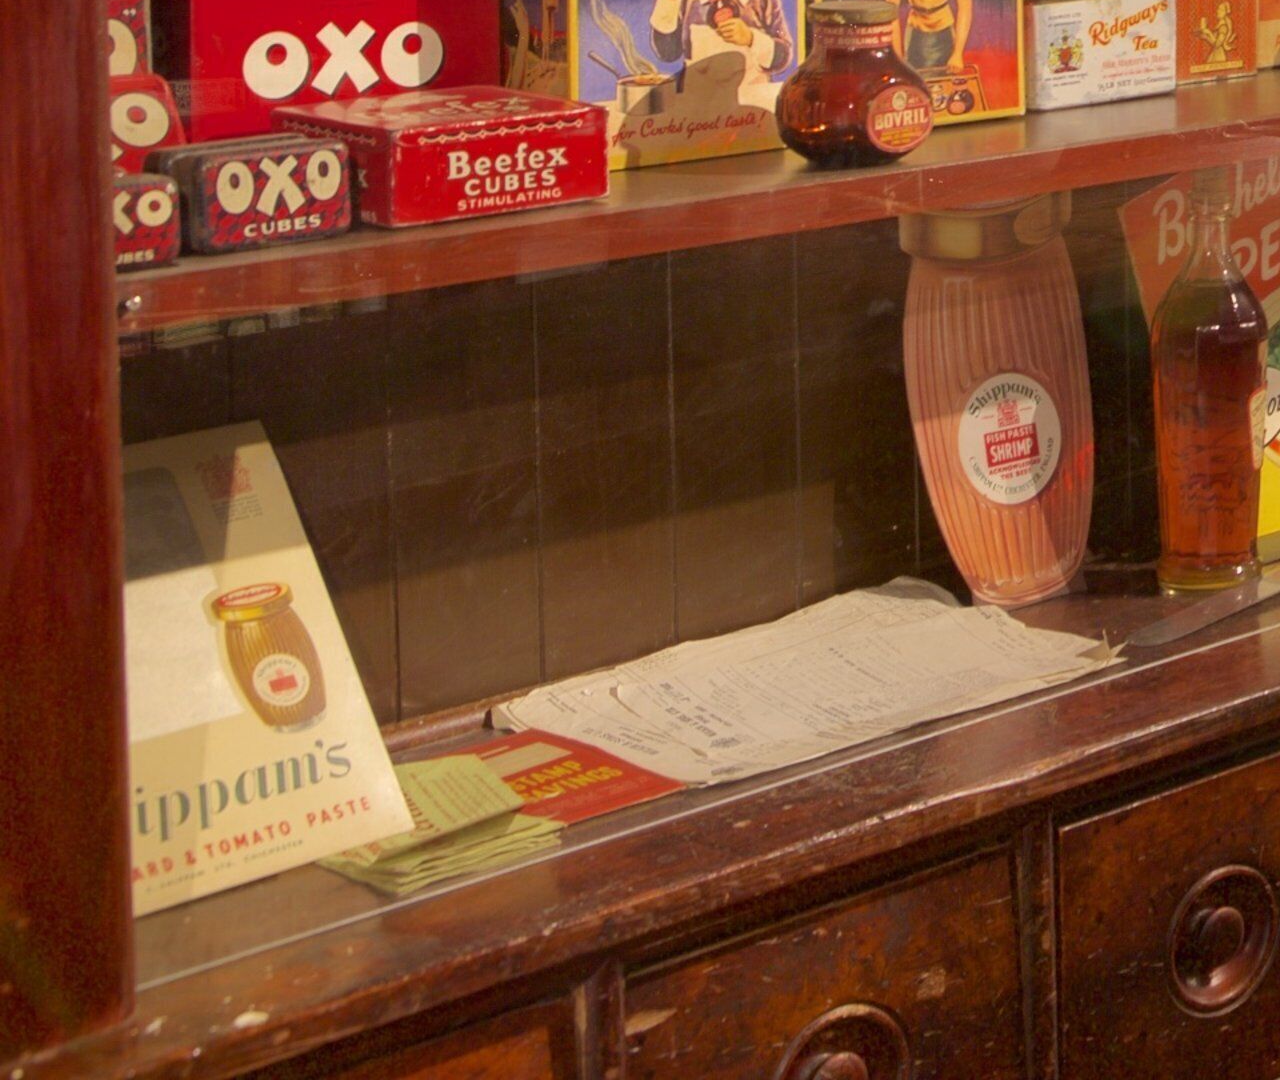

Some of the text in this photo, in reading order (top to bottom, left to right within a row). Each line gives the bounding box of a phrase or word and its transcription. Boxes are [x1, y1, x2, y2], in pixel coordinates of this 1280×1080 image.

[1088, 0, 1168, 46] Ridgways
[1133, 35, 1158, 51] Tea
[242, 19, 444, 101] OXO
[612, 125, 637, 148] for
[687, 115, 720, 139] good
[725, 111, 767, 129] taste!
[874, 108, 929, 130] BOVRIL
[447, 143, 568, 180] Beefex
[216, 149, 341, 218] OXO
[464, 169, 557, 197] CUBES
[457, 187, 562, 212] STIMULATING
[244, 214, 322, 238] CUBES
[969, 382, 1043, 418] Shippam's
[986, 426, 1035, 444] FISH PASTE
[990, 438, 1033, 463] SHRIMP
[512, 761, 582, 791] STAMP
[185, 850, 197, 865] &
[204, 820, 292, 858] TOMATO
[306, 796, 371, 827] PASTE
